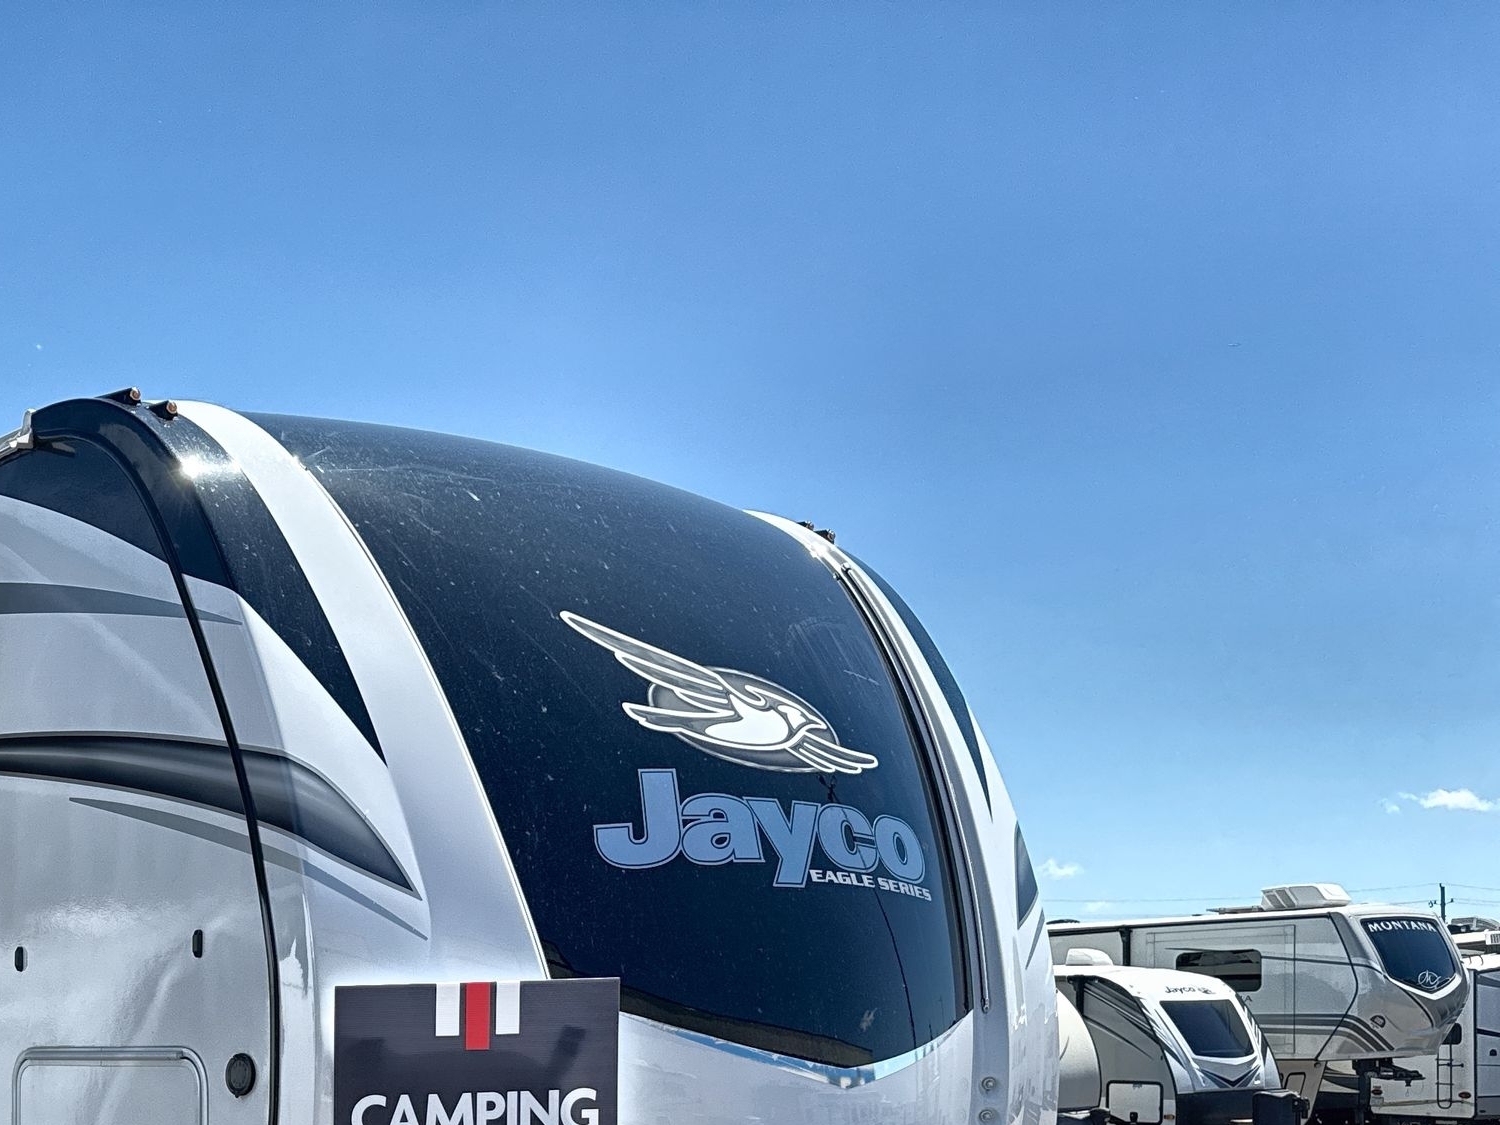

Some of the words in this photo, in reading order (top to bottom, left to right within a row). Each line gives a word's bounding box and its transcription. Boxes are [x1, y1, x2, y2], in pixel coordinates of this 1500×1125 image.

[593, 768, 926, 888] Jayco
[809, 869, 876, 888] EAGLE
[877, 877, 932, 901] SERIES
[1367, 920, 1437, 933] MONTANA
